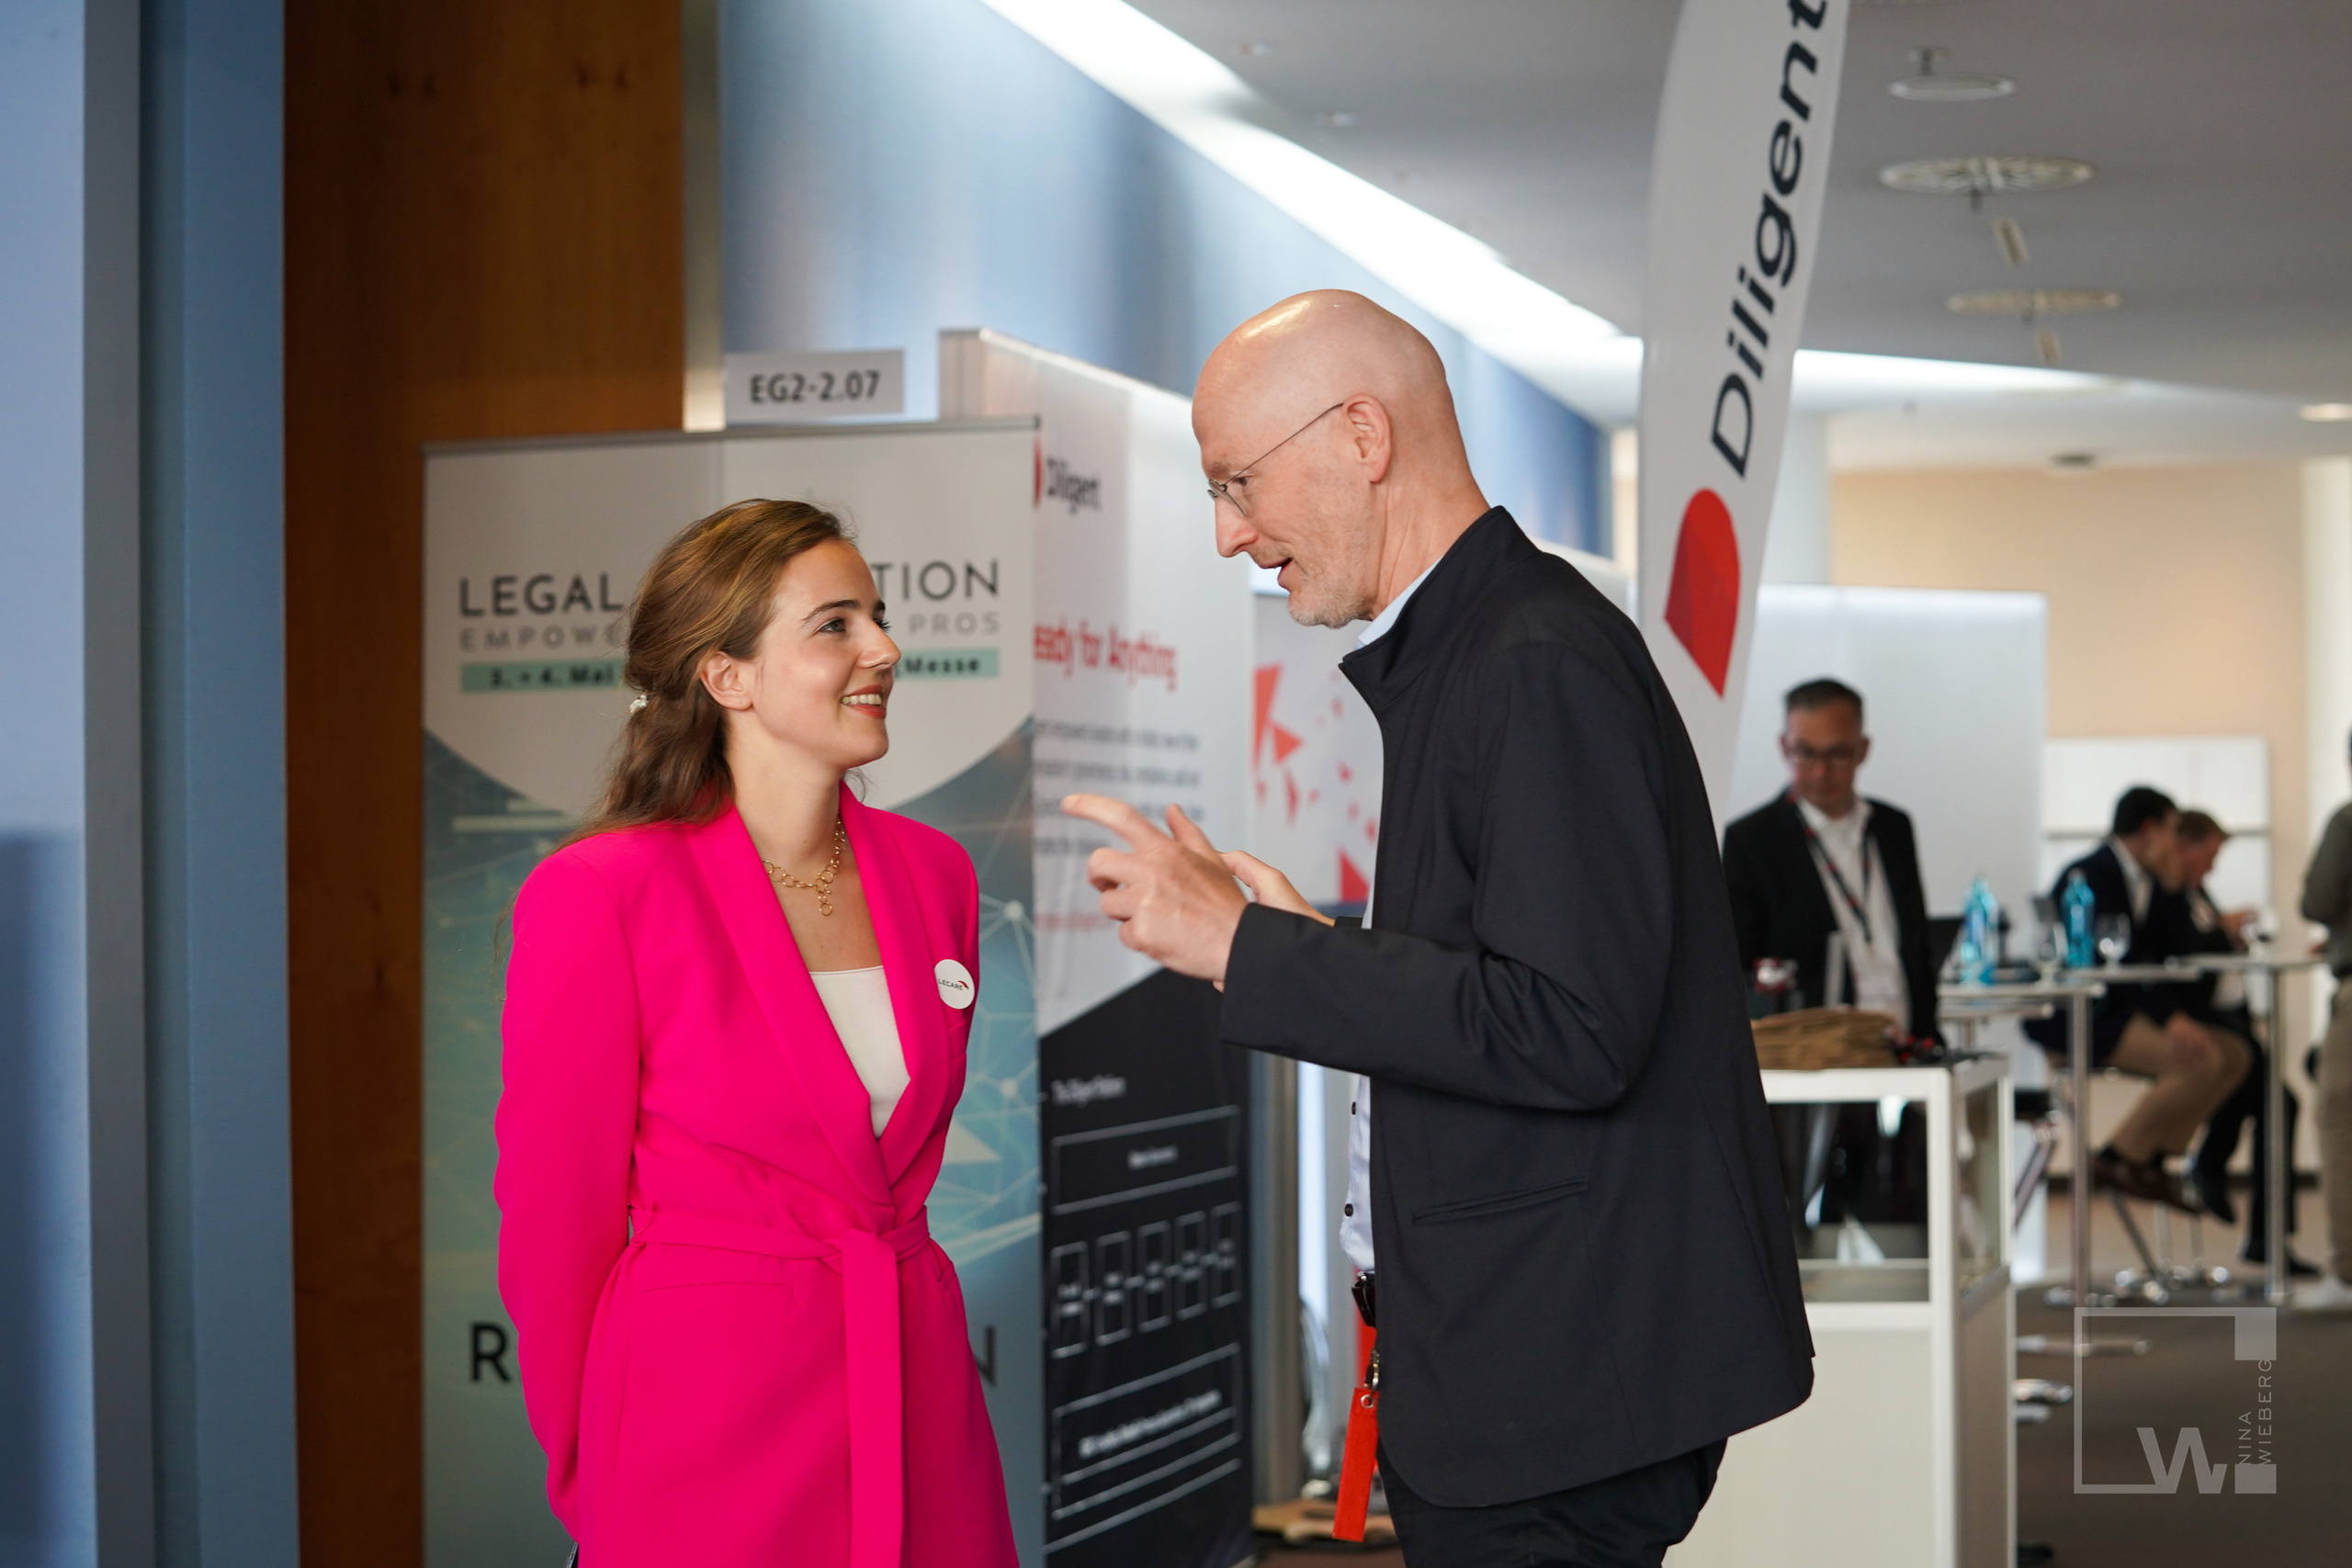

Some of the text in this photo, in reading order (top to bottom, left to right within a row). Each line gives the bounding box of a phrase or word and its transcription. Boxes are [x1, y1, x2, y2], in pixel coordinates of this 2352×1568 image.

[1711, 0, 1826, 480] Diligent
[749, 369, 881, 404] EG2-2.07
[460, 558, 999, 616] LEGAL TION
[909, 611, 1001, 636] PROS
[905, 656, 979, 674] Messe
